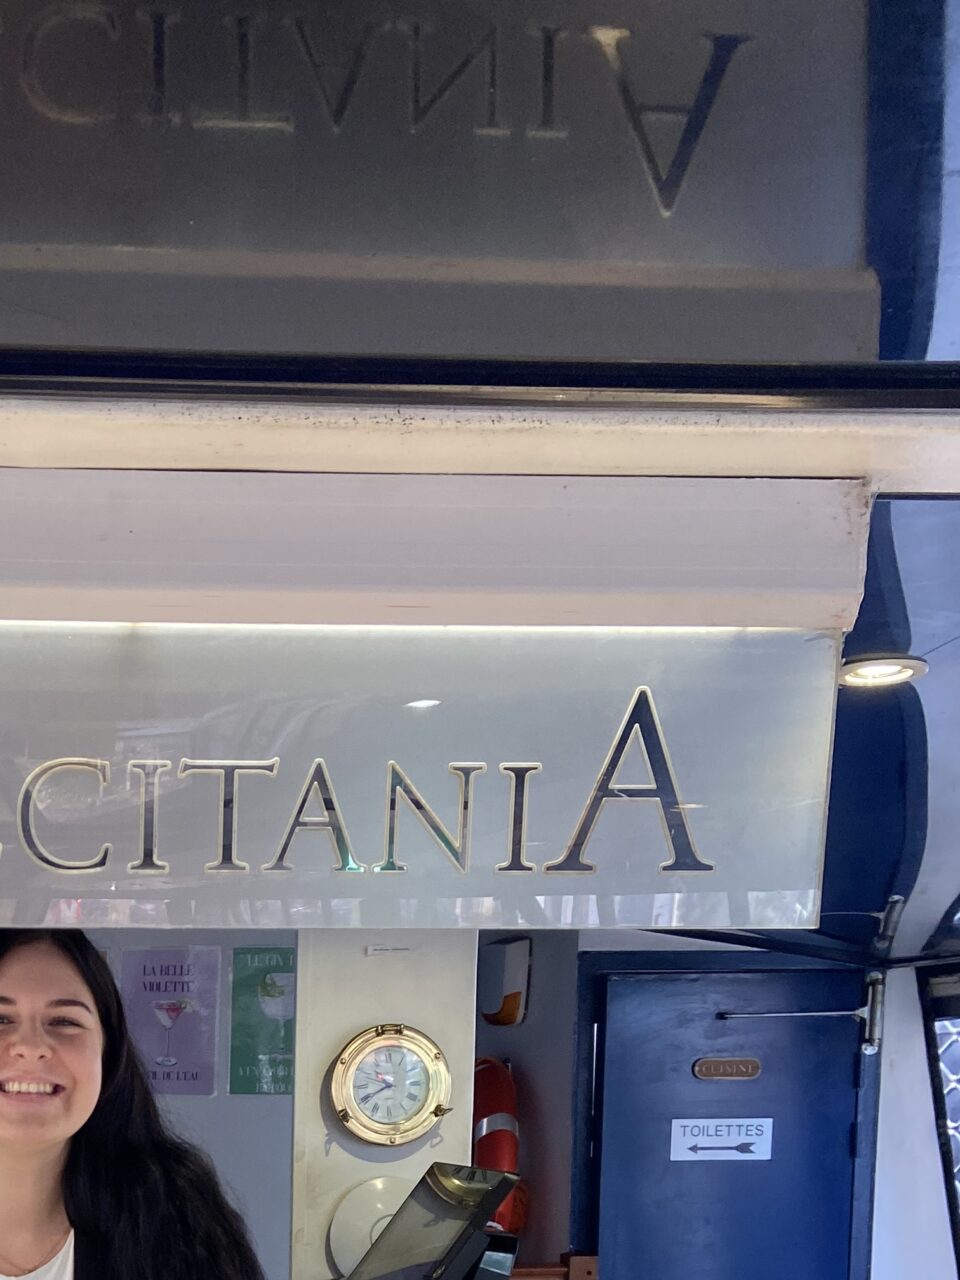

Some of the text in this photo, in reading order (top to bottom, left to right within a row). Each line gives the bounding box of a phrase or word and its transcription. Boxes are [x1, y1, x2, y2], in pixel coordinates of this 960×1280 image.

[143, 964, 194, 976] LA BELLE
[143, 981, 194, 993] VIOLETTE
[680, 1124, 764, 1137] TOILETTES
